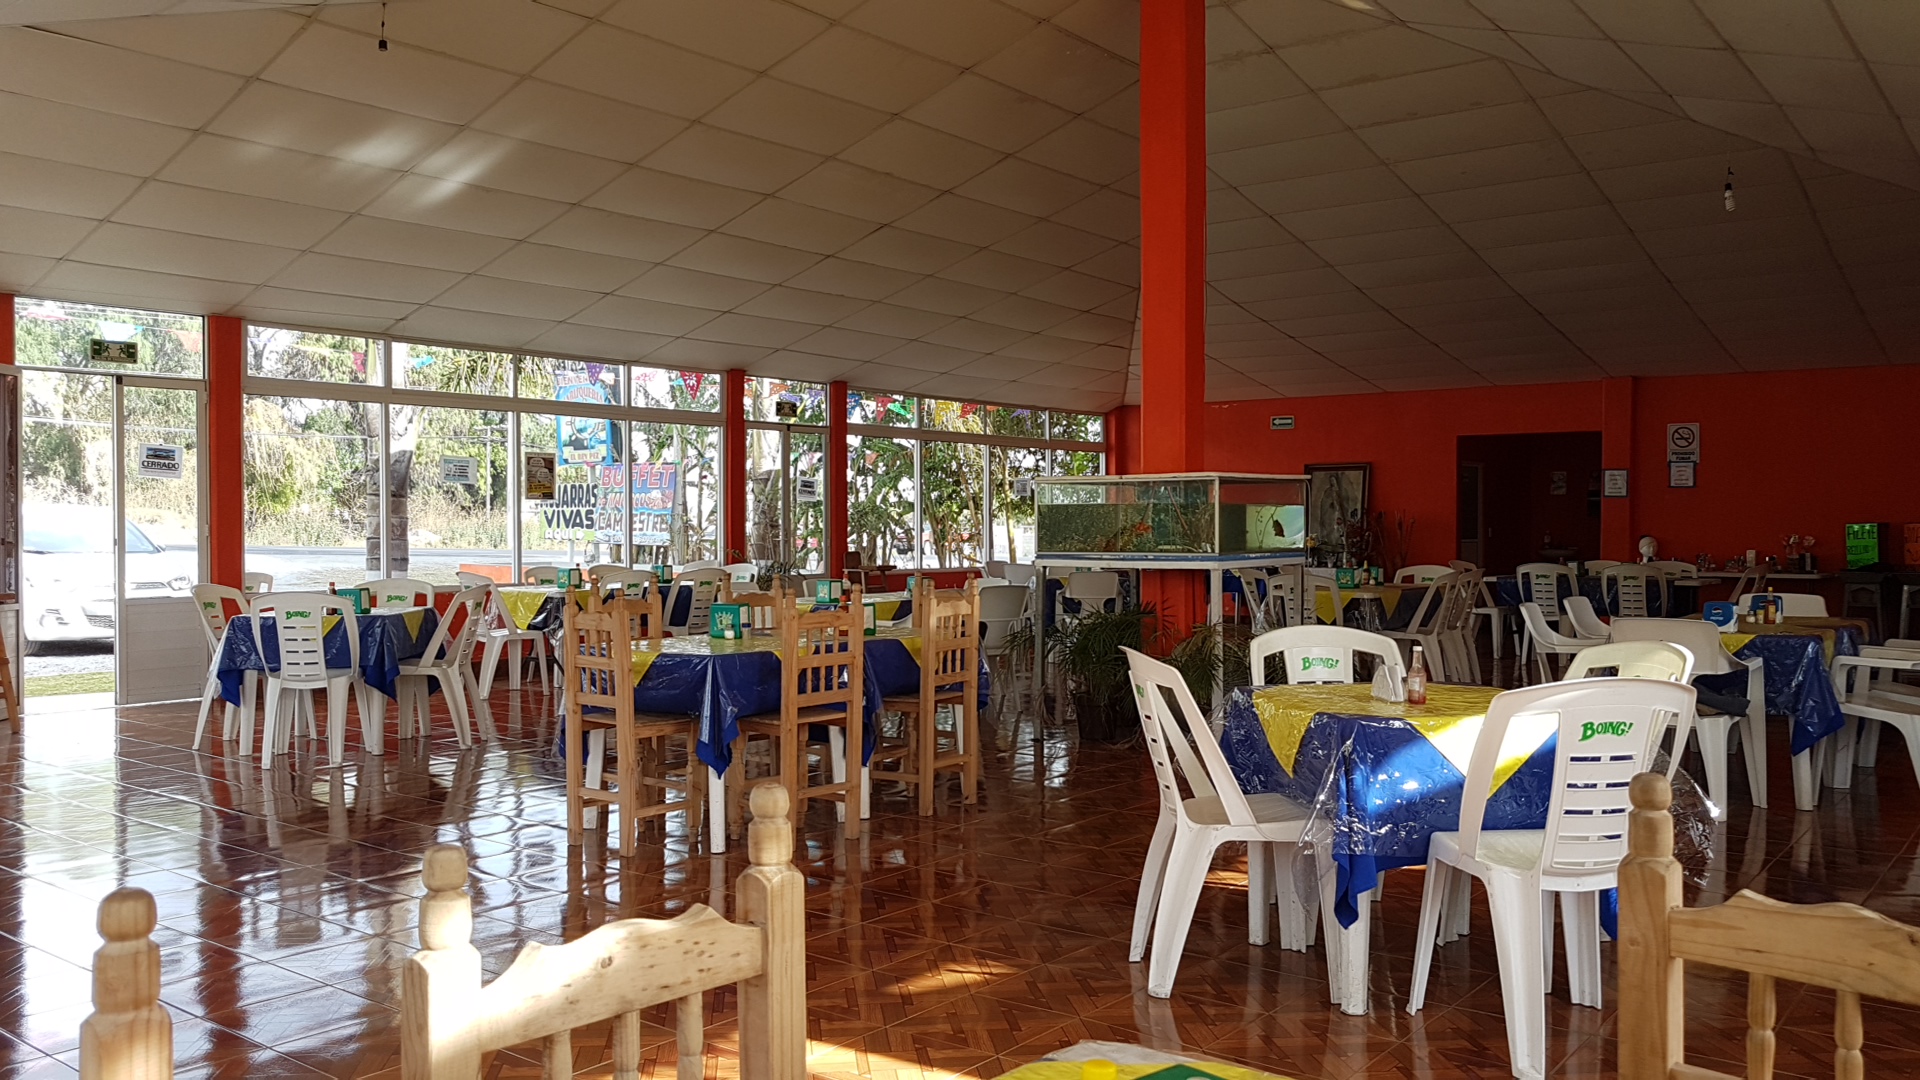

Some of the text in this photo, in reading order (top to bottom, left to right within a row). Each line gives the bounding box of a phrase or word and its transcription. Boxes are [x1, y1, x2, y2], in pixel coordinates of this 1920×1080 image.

[141, 460, 180, 470] CERRADO
[540, 483, 598, 508] JARRAS
[544, 509, 594, 530] VIVAS
[598, 511, 669, 533] CAMESTRE
[545, 529, 573, 541] AQUI
[386, 594, 408, 603] BOING!
[285, 611, 311, 620] BOING!
[1301, 656, 1340, 671] BOING!
[1578, 721, 1634, 743] BOING!
